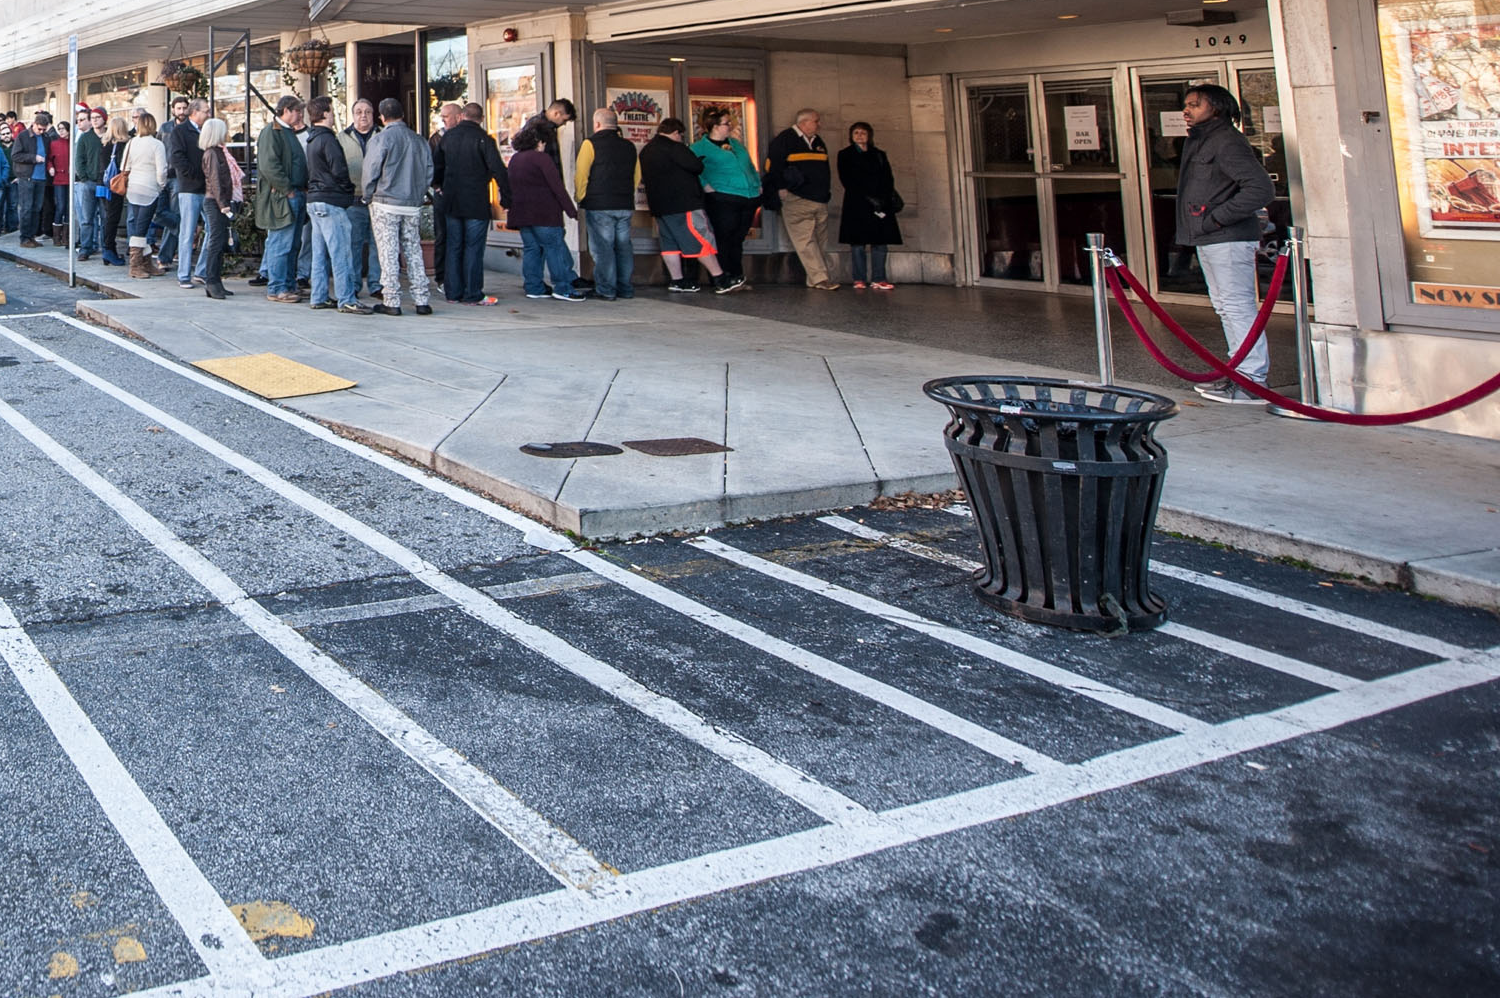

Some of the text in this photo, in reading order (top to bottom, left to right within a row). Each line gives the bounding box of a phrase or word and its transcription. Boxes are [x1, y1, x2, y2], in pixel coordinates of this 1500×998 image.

[1195, 34, 1246, 48] 1049
[623, 112, 649, 122] THEATRE
[1419, 288, 1477, 303] NOW
